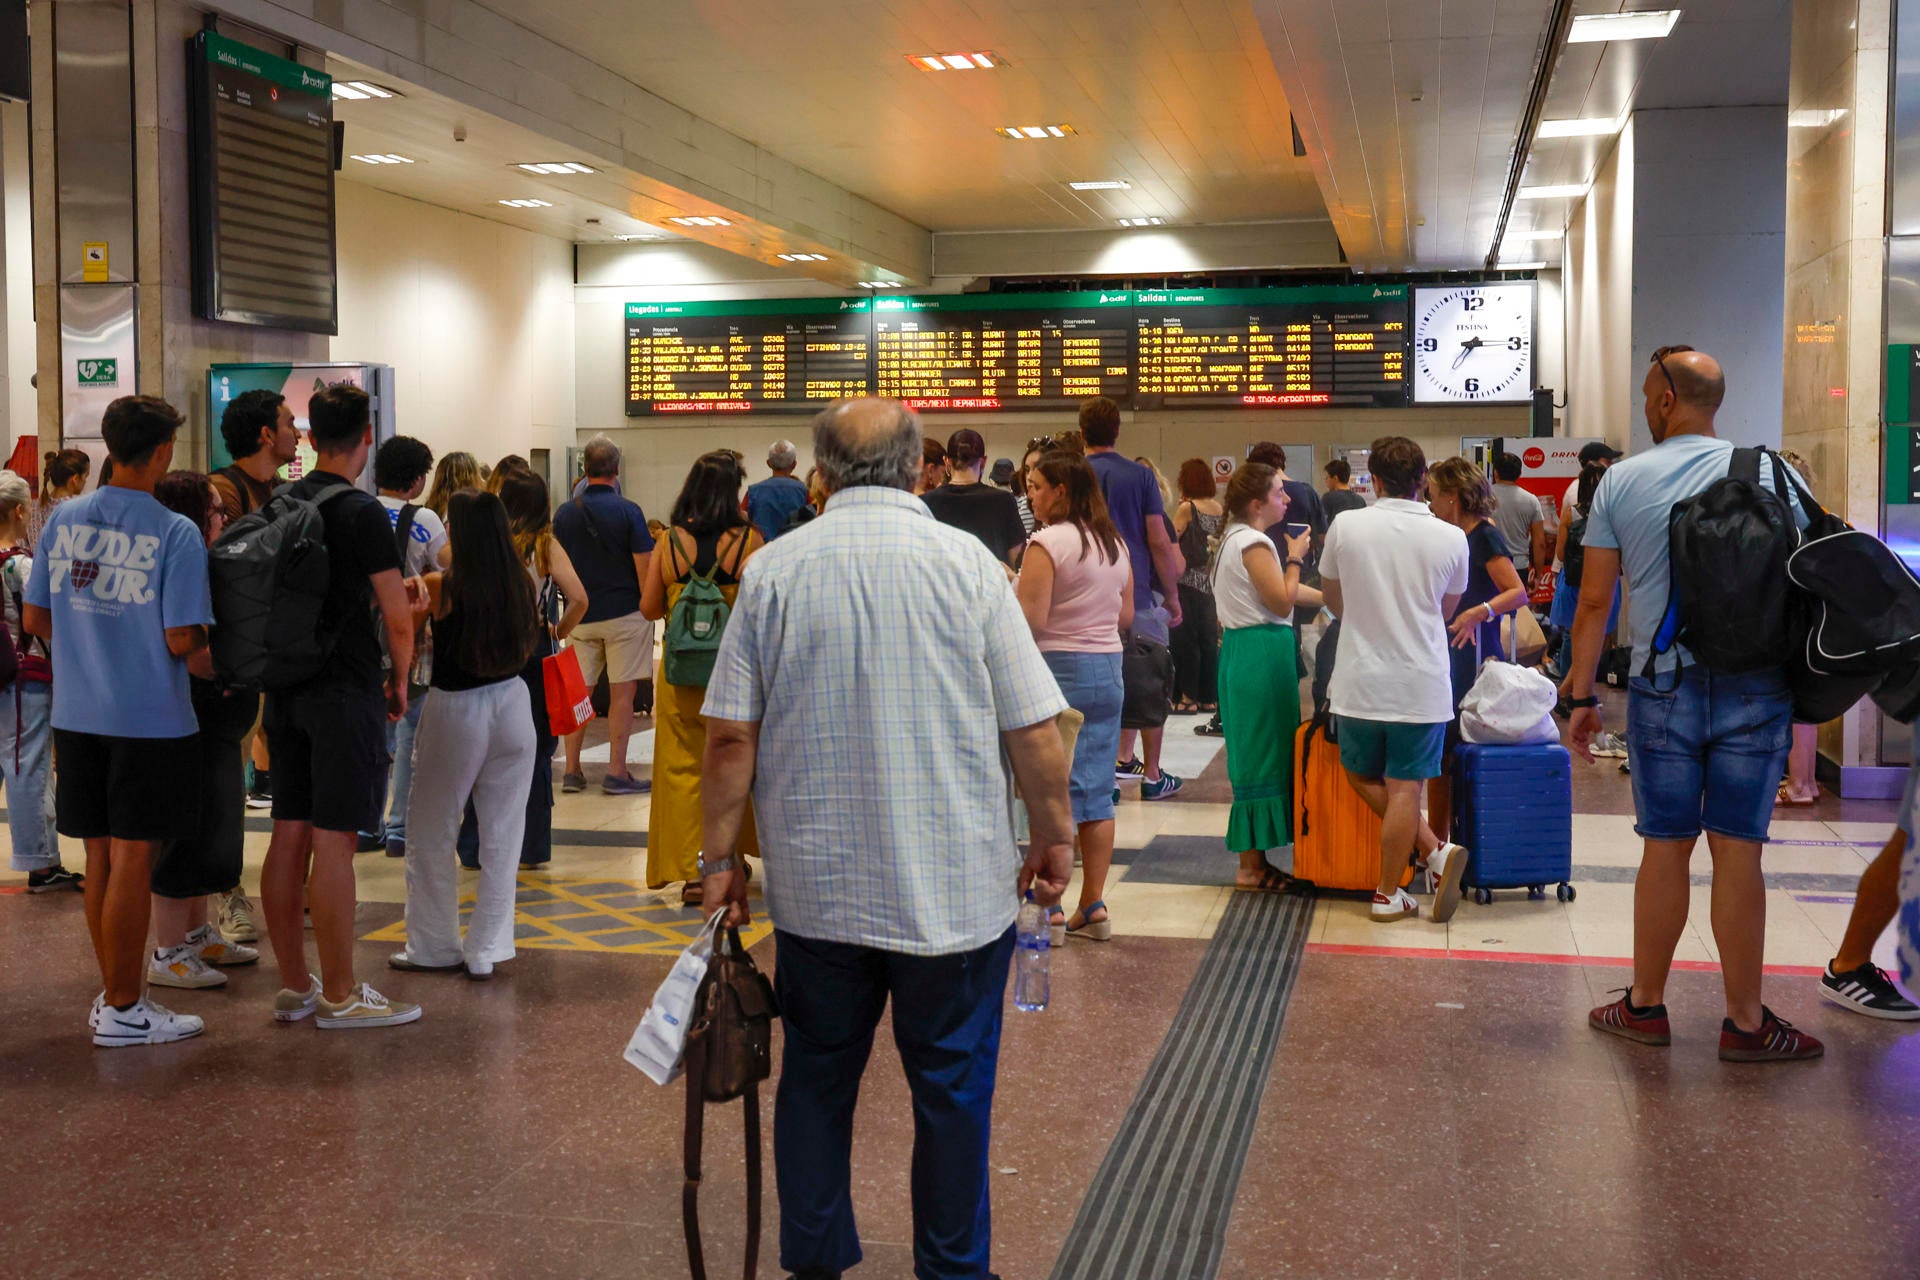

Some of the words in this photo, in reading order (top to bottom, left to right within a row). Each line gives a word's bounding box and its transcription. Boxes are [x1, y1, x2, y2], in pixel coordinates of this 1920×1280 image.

[1138, 294, 1167, 303] Salidas
[1461, 297, 1485, 311] 12
[1423, 338, 1438, 352] 9
[1507, 336, 1522, 351] 3
[901, 369, 942, 378] SANTANDER
[901, 379, 929, 388] MURCIA
[1464, 378, 1479, 392] 6
[48, 524, 160, 571] NUDE
